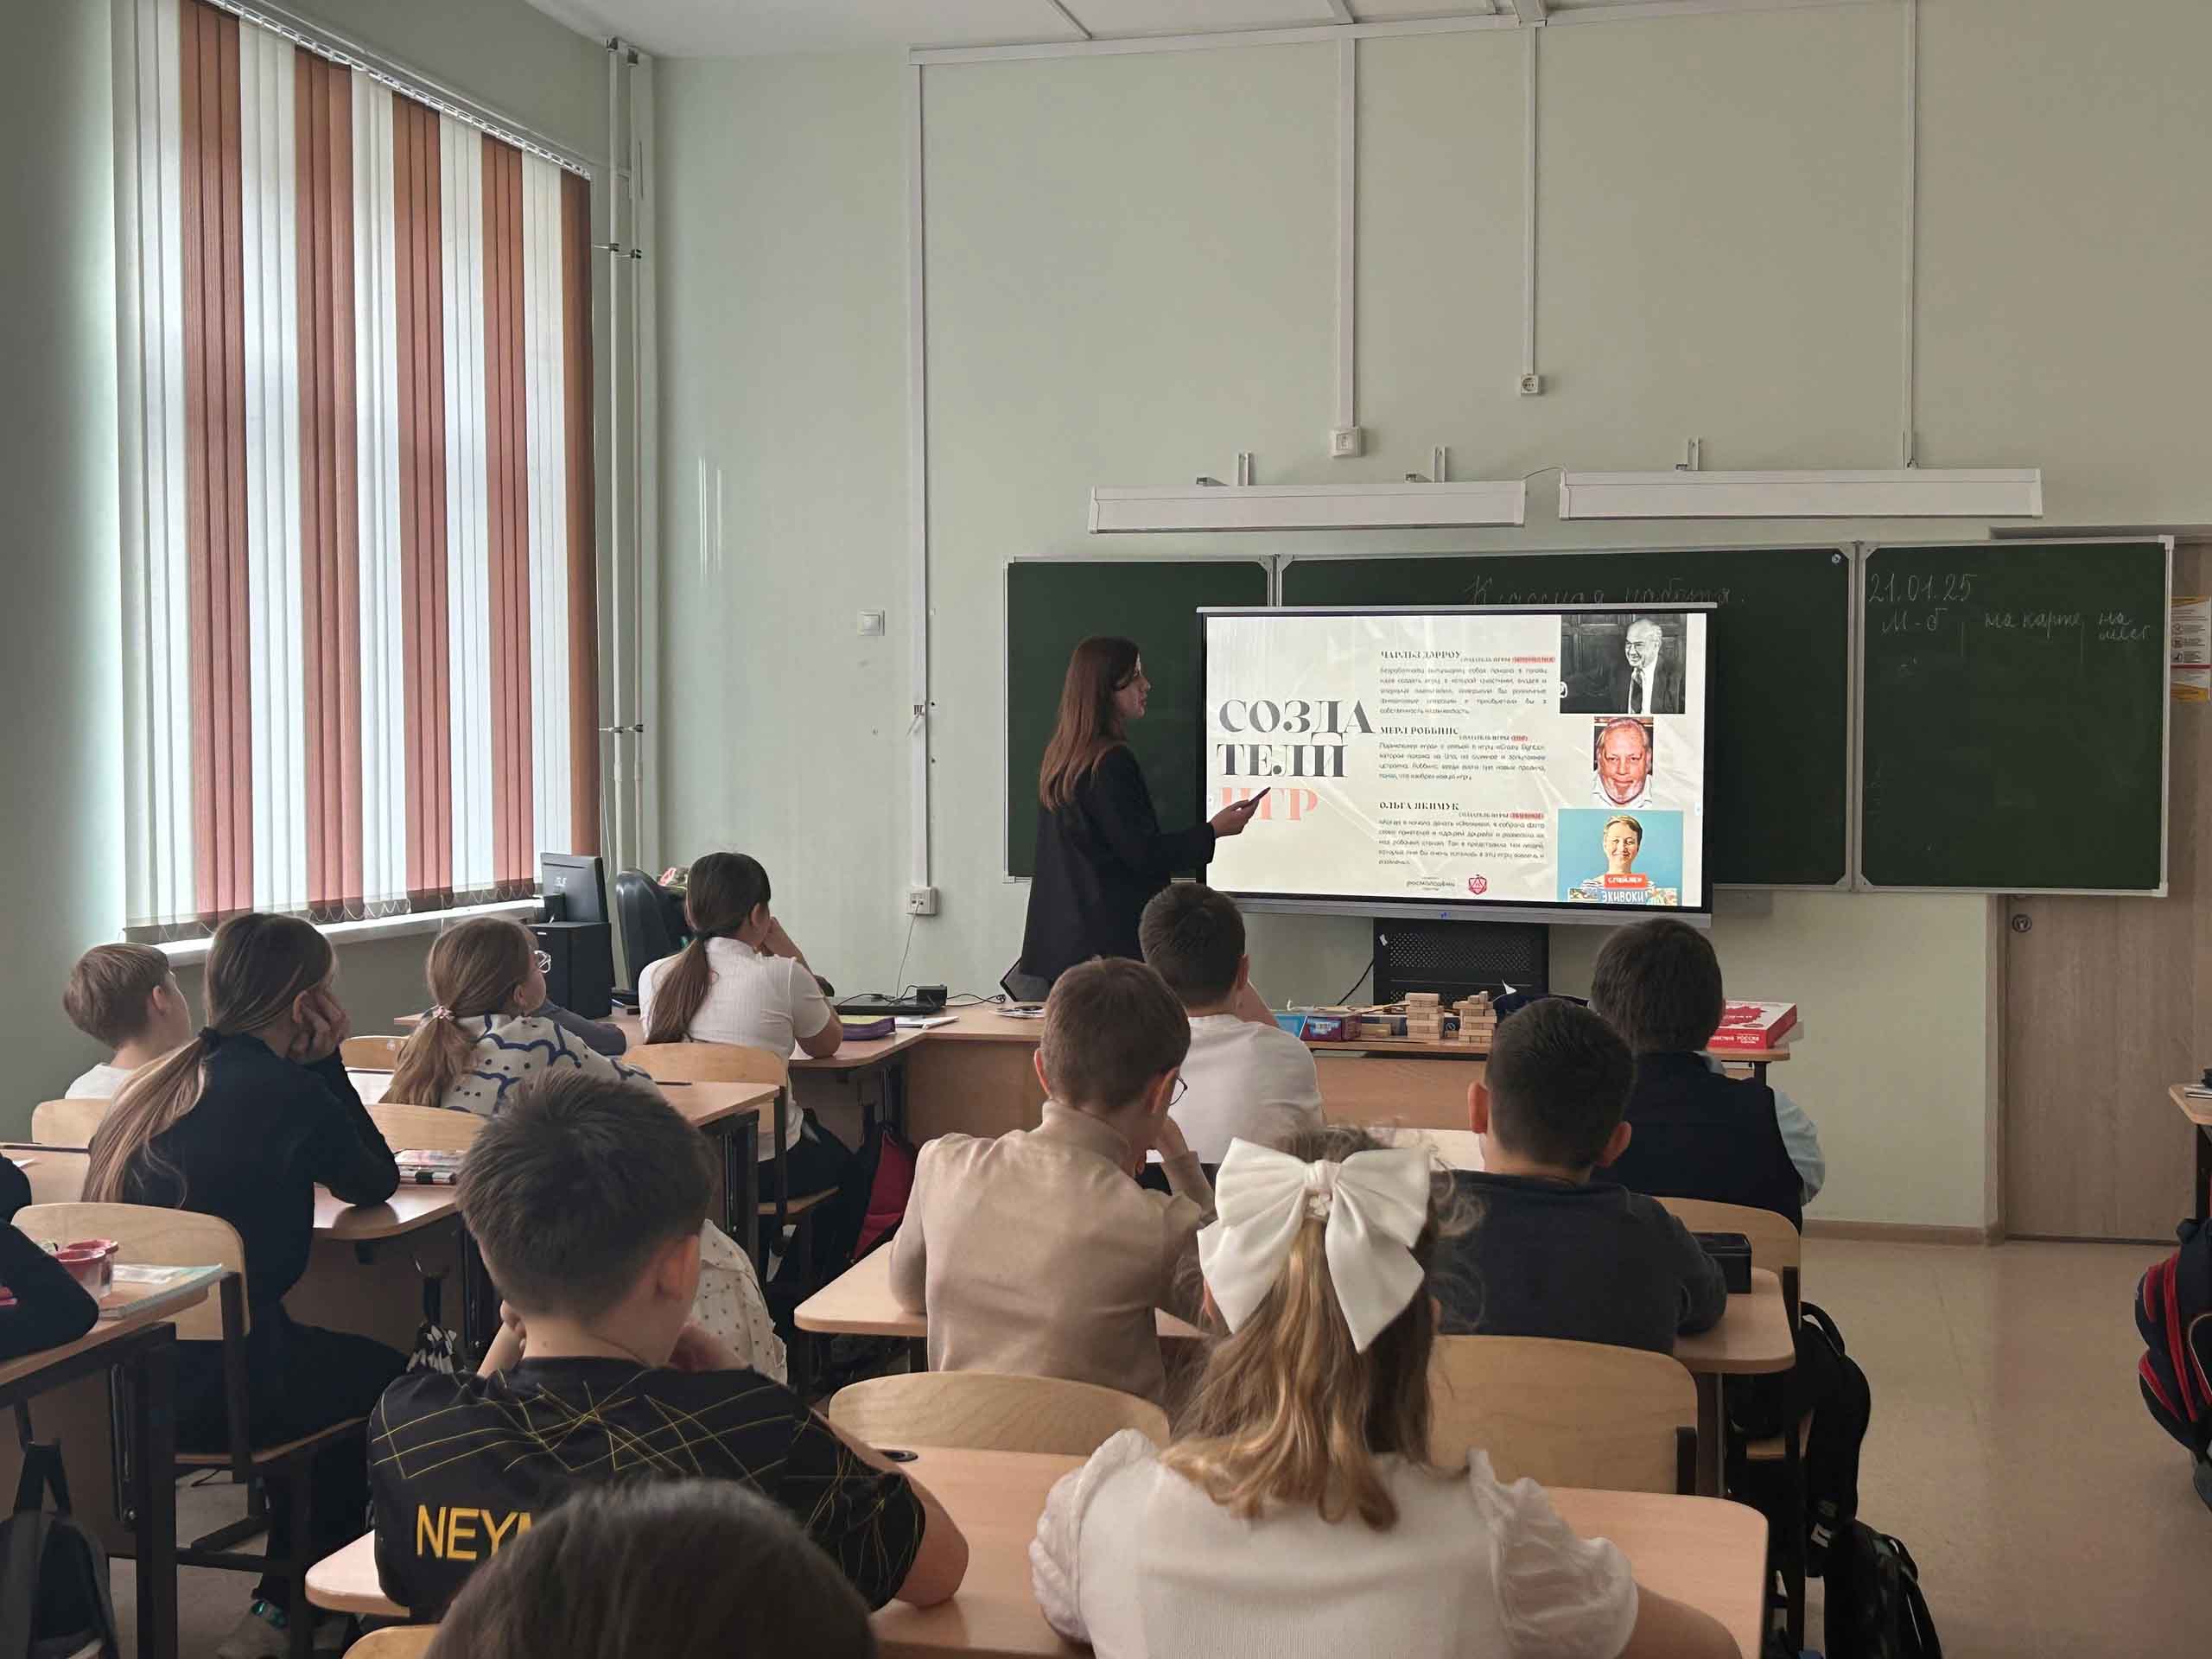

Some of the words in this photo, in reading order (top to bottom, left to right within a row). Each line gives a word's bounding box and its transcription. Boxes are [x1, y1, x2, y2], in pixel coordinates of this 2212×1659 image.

[1868, 573, 1977, 602] 21.01.25
[1219, 699, 1373, 744] СОЗДА
[1217, 744, 1348, 777] ТЕЛИ
[416, 1504, 532, 1560] NEY
